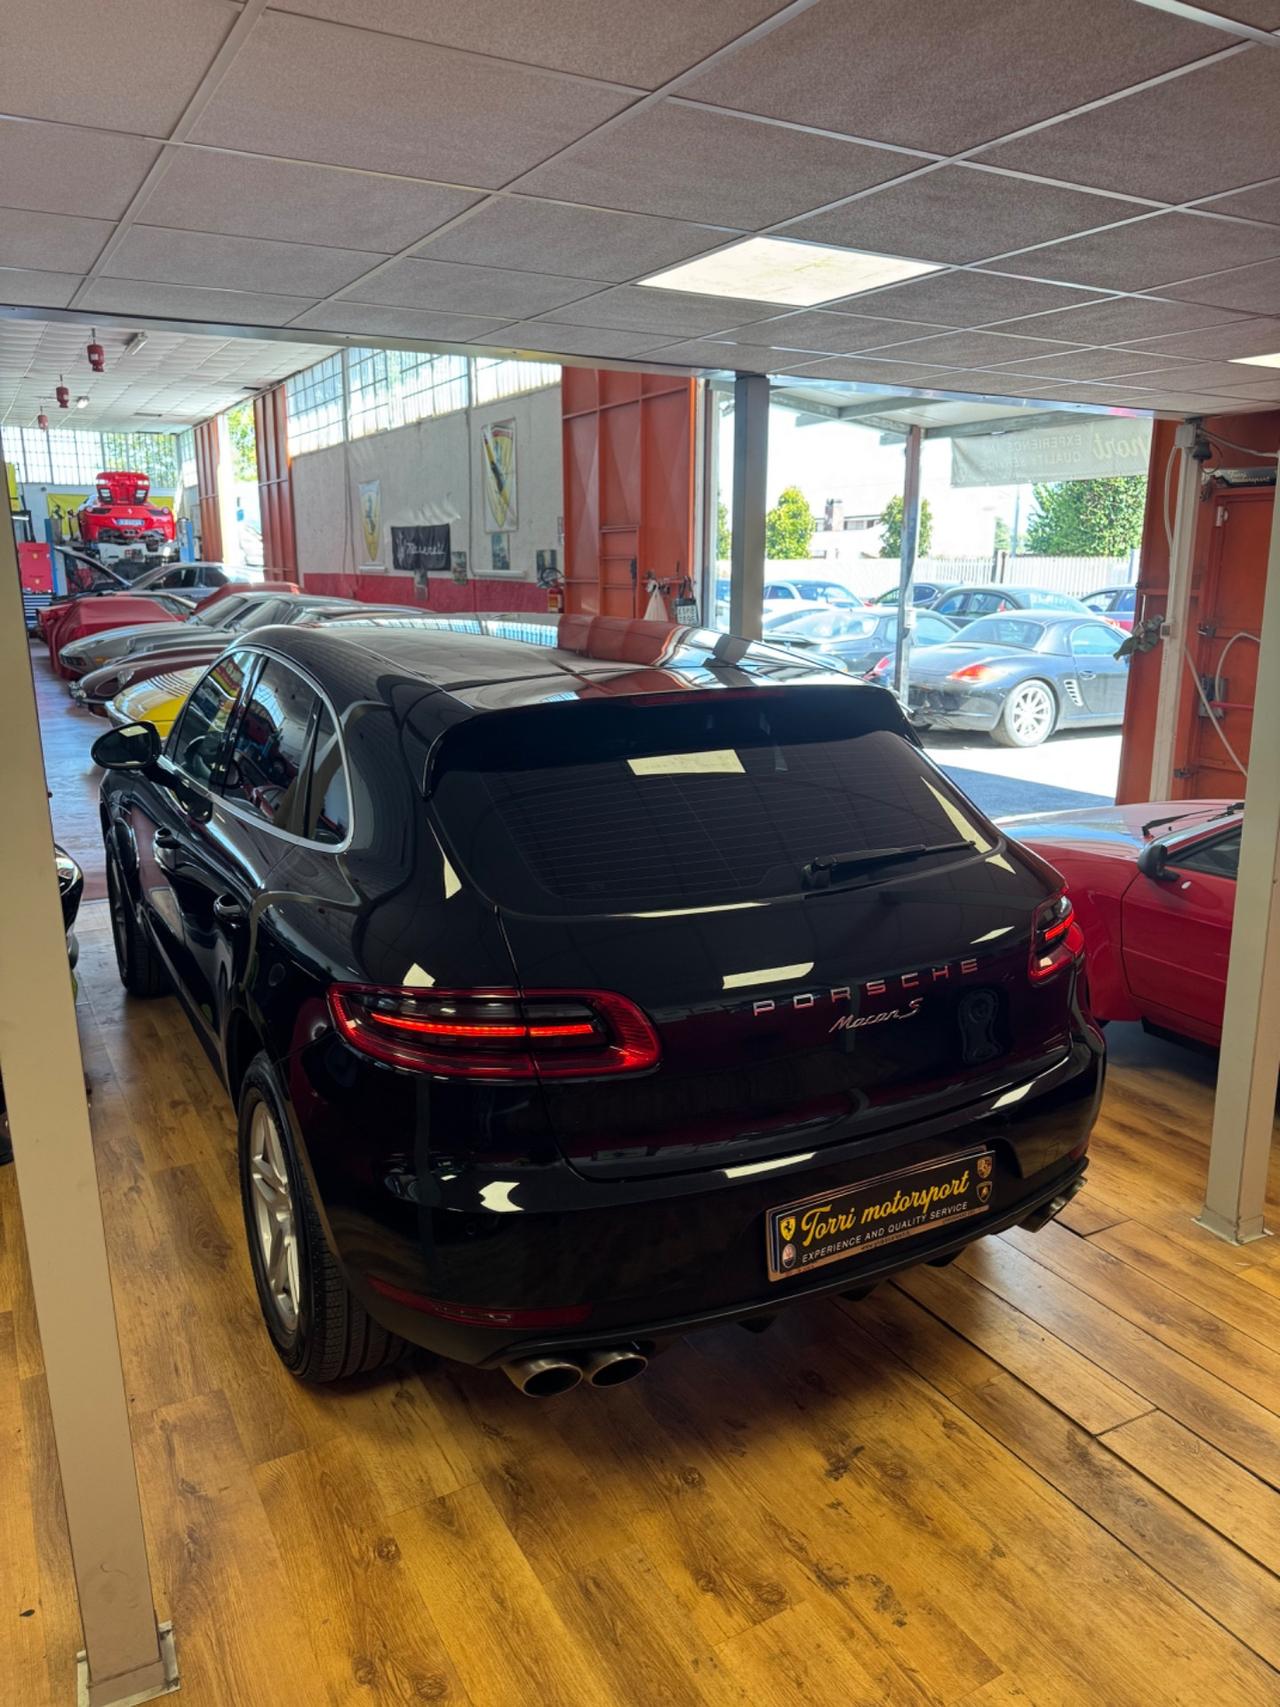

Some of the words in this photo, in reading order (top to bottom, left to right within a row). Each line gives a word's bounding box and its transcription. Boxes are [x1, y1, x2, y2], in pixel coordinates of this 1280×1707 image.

[753, 958, 978, 1016] PORSCHE
[828, 1009, 899, 1033] Macan
[801, 1204, 857, 1247] Torri
[860, 1170, 969, 1219] motorsport
[802, 1235, 862, 1263] EXPERIENCE
[864, 1228, 885, 1242] AND
[887, 1214, 928, 1235] QUALITY
[929, 1201, 969, 1219] SERVICE
